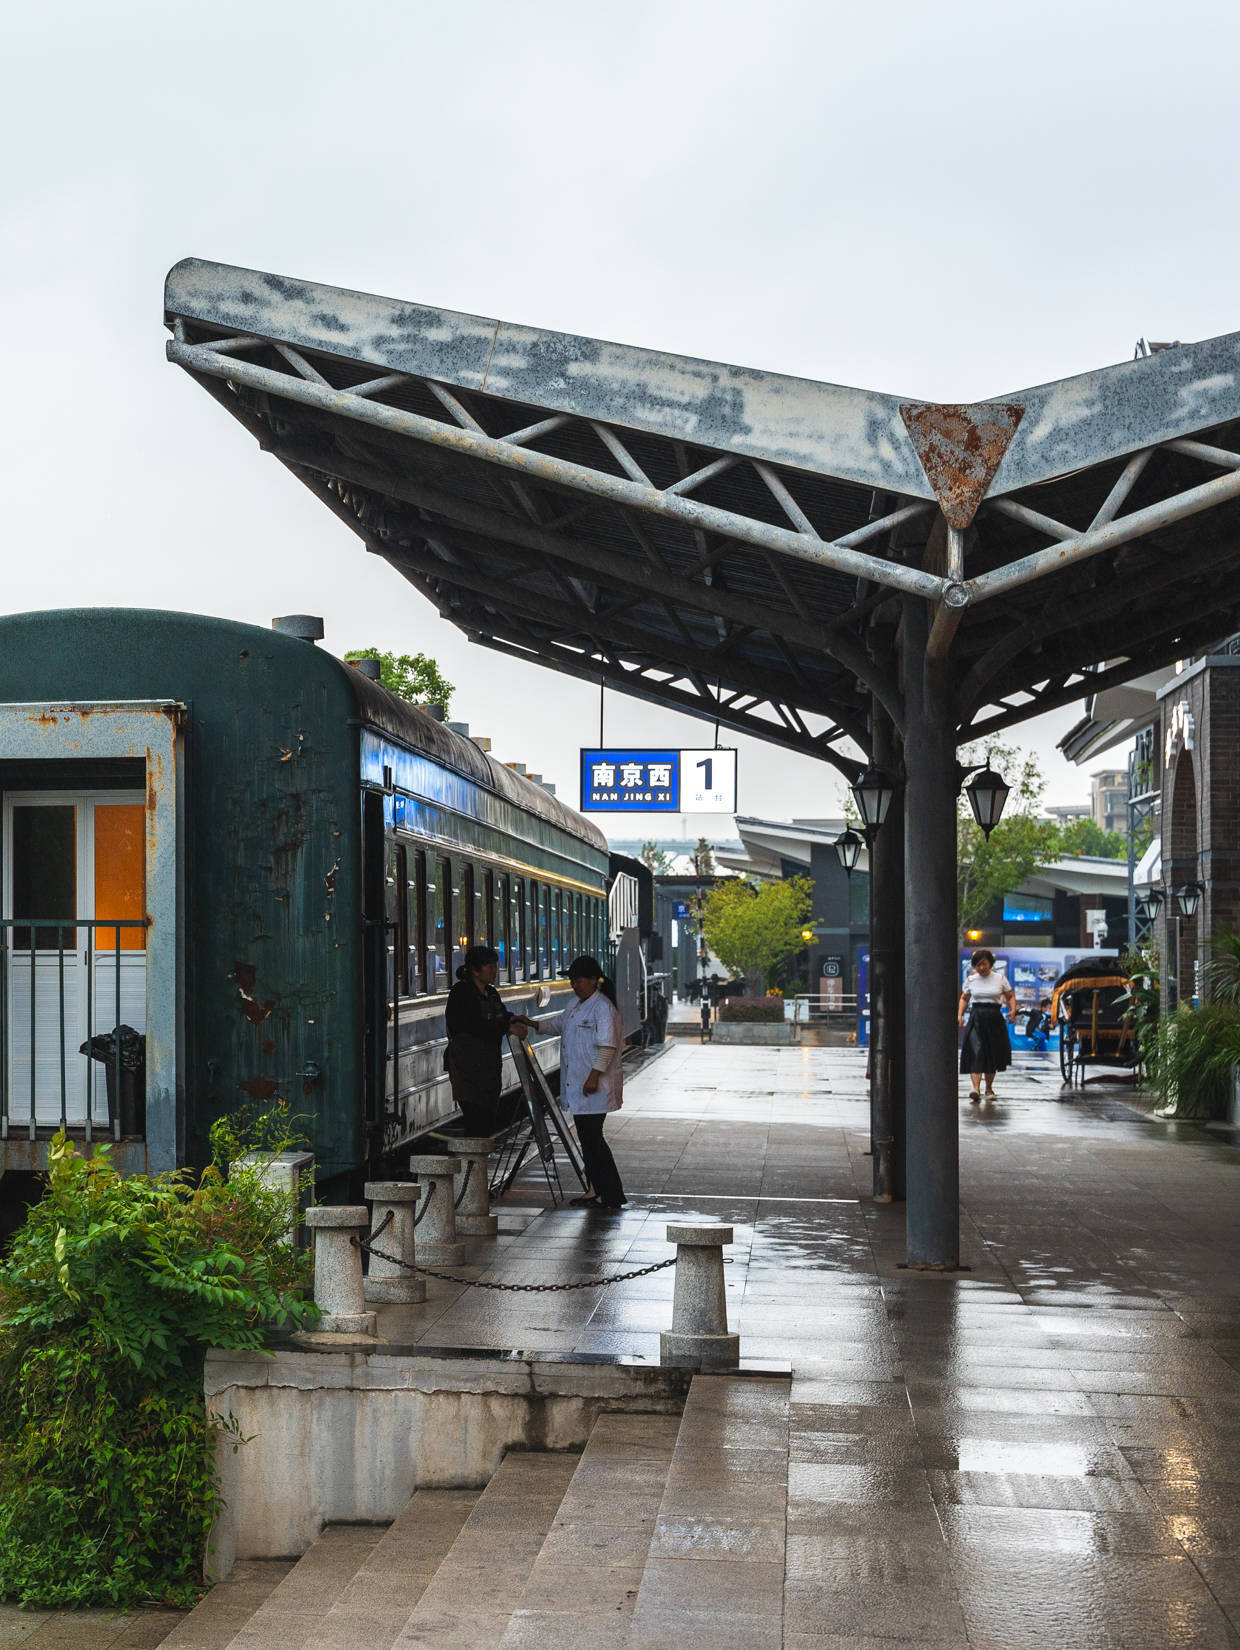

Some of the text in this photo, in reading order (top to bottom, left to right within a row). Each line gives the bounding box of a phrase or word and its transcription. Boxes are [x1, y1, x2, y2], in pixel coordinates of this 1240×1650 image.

[592, 762, 672, 788] 南京西
[696, 758, 713, 790] 1
[592, 792, 670, 801] NAN JING XI
